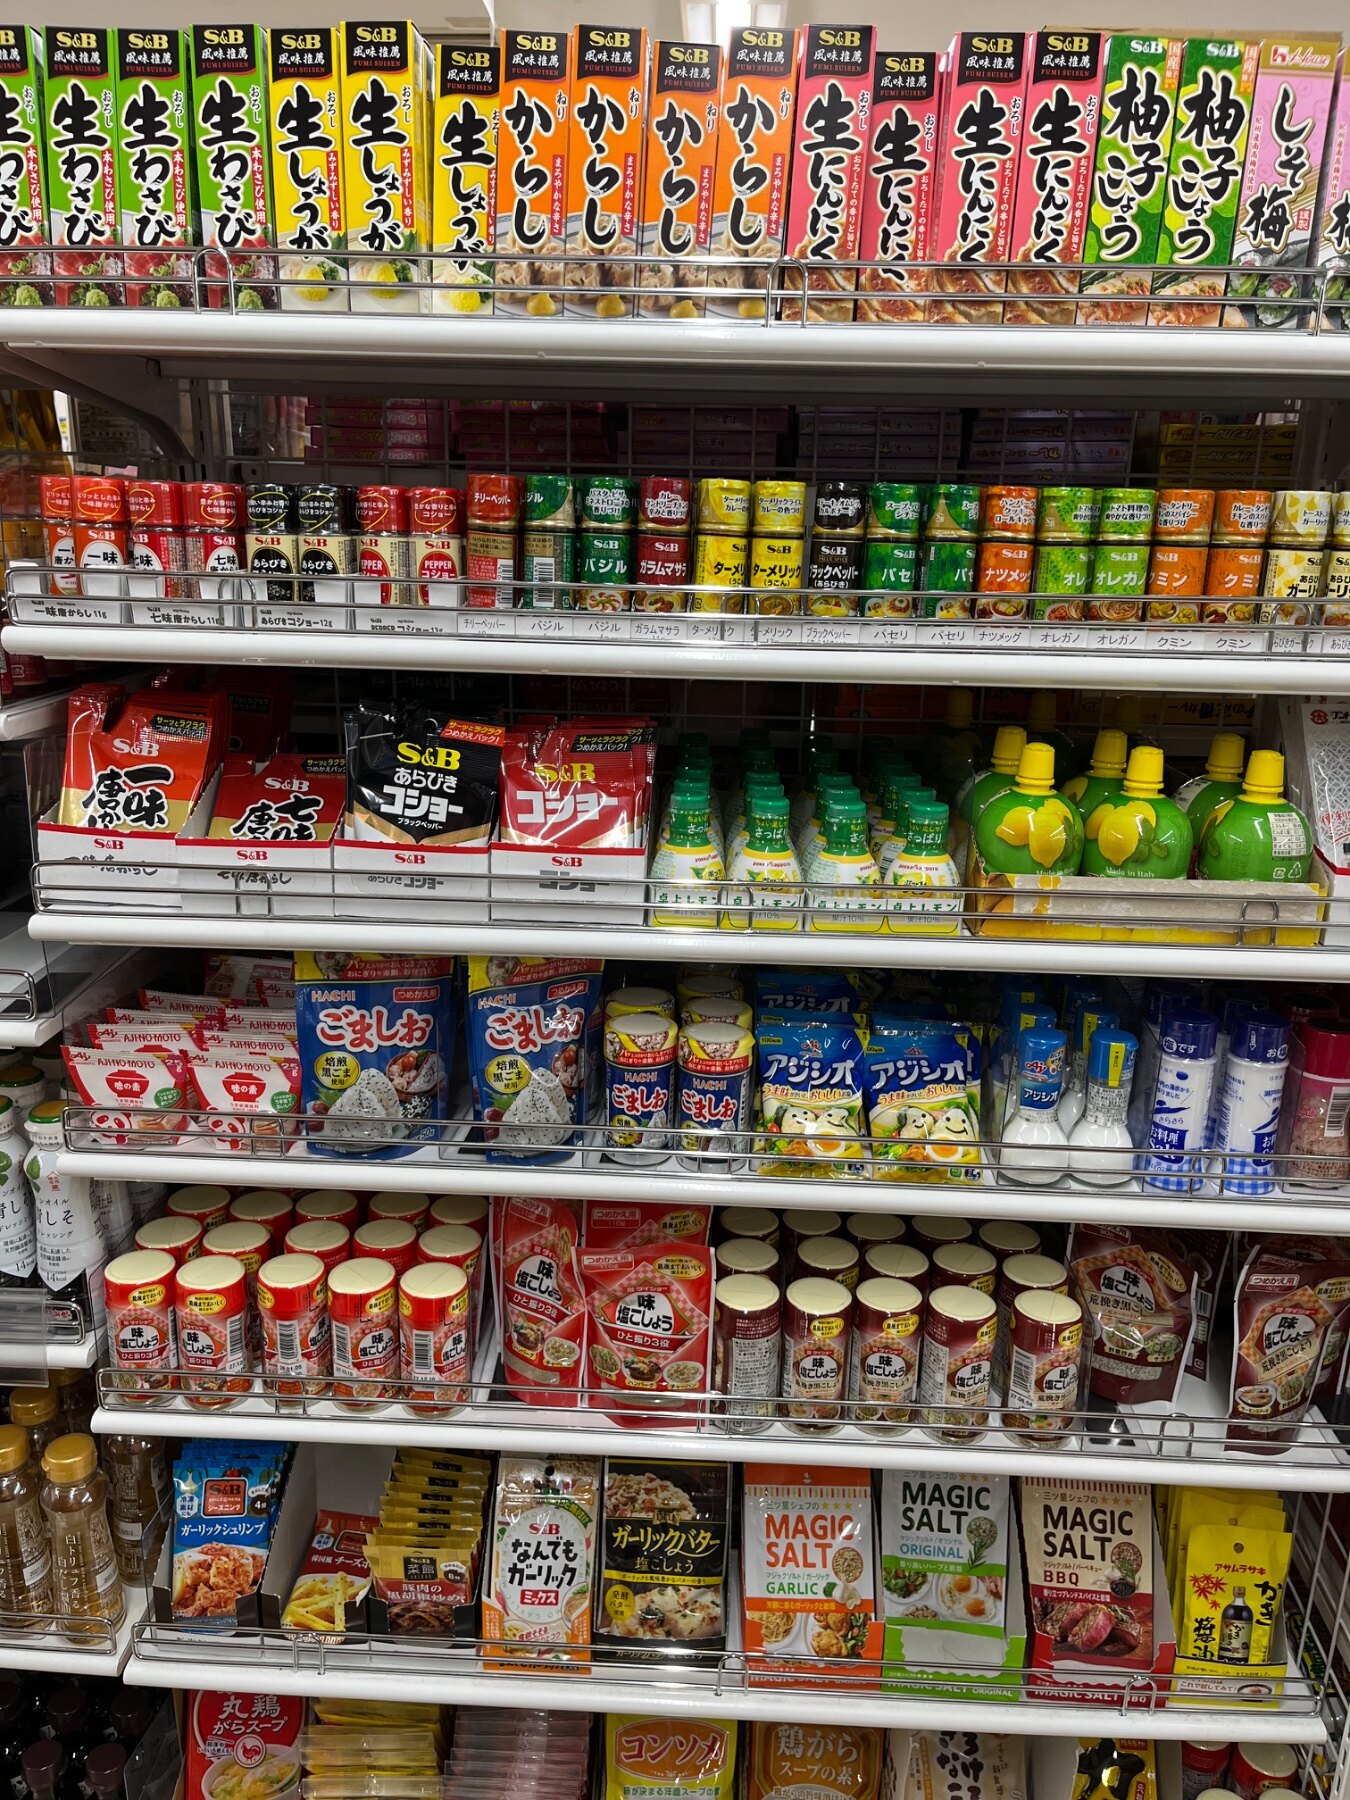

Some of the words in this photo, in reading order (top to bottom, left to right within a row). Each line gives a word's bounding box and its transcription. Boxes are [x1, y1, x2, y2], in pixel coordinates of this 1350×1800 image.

[57, 32, 96, 48] S&B
[129, 34, 168, 49] S&B
[204, 29, 244, 44] S&B
[281, 34, 321, 49] S&B
[356, 26, 397, 42] S&B
[589, 31, 630, 47] S&B
[516, 35, 556, 51] S&B
[54, 50, 100, 63] 風味推薦
[126, 51, 172, 65] 風味推薦
[202, 46, 249, 61] 風味推薦
[278, 51, 325, 65] 風味推薦
[354, 46, 400, 60] 風味推薦
[451, 51, 489, 67] S&B
[669, 47, 708, 63] S&B
[557, 91, 567, 120] ねり
[54, 83, 108, 244] 生わさび
[124, 83, 179, 246] 生わさび
[202, 79, 257, 243] 生わさび
[352, 78, 409, 250] 生しょうが
[506, 90, 552, 245] からし
[577, 87, 624, 246] からし
[728, 88, 775, 246] からし
[655, 102, 701, 254] からし
[804, 84, 859, 260] 生にんにく
[956, 90, 1012, 261] 生にんにく
[1030, 88, 1087, 262] 生にんにく
[553, 156, 562, 233] まろやかな辛さ
[475, 493, 511, 503] チリーペッパー
[88, 530, 115, 540] S&B
[214, 536, 235, 545] S&B
[255, 537, 281, 545] S&B
[304, 539, 327, 547] S&B
[425, 541, 450, 549] S&B
[594, 540, 618, 549] S&B
[87, 552, 118, 564] 一味
[253, 560, 287, 568] あらびき
[425, 560, 452, 570] PEPPER
[585, 558, 627, 573] バジル
[640, 560, 687, 575] ガラムマサラ
[464, 619, 506, 628] チリーペッパー
[532, 621, 564, 631] バジル
[588, 622, 621, 632] バジル
[635, 624, 679, 634] ガラムマサラ
[807, 628, 852, 638] ブラックペッパー
[874, 629, 908, 639] パセリ
[931, 632, 965, 641] パセリ
[979, 633, 1022, 643] ナツメッグ
[1041, 633, 1080, 643] オレガノ
[1097, 634, 1137, 645] オレガノ
[1157, 637, 1192, 648] クミン
[1216, 638, 1251, 648] クミン
[113, 738, 159, 756] S&B
[397, 742, 461, 770] S&B
[533, 762, 596, 783] S&B
[264, 778, 309, 791] S&B
[394, 768, 458, 793] あらびき
[380, 785, 463, 822] コショー
[516, 790, 618, 824] コショー
[398, 817, 443, 830] ブラックペッパー
[94, 839, 124, 850] S&B
[237, 851, 268, 860] S&B
[394, 854, 425, 864] S&B
[552, 857, 582, 867] S&B
[311, 990, 355, 1002] HACHI
[397, 988, 437, 1000] つめかえ用
[319, 1008, 433, 1049] ごましお
[487, 1007, 583, 1051] ごましお
[322, 1068, 351, 1079] 黒ごま
[625, 1072, 657, 1083] HACHI
[764, 1055, 854, 1085] アジシオ
[871, 1061, 965, 1090] アジシオ
[114, 1082, 141, 1092] 味の素
[231, 1084, 257, 1094] 味の素
[693, 1079, 727, 1090] HACHI
[612, 1084, 668, 1114] ごましお
[1024, 1088, 1059, 1102] アジシオ
[682, 1090, 737, 1121] ごましお
[537, 1260, 554, 1280] 味
[516, 1269, 562, 1301] 塩こしょう
[1122, 1270, 1141, 1289] 味
[1102, 1275, 1154, 1311] 塩こしょう
[513, 1293, 557, 1319] ひと振り3役
[638, 1294, 655, 1310] 味
[618, 1306, 673, 1332] 塩こしょう
[1278, 1316, 1297, 1329] 味
[131, 1327, 144, 1338] 味
[187, 1331, 199, 1342] 味
[372, 1332, 384, 1345] 味
[617, 1330, 670, 1348] ひと振り3役
[812, 1357, 824, 1368] 味
[209, 1485, 241, 1495] S&B
[902, 1481, 990, 1511] MAGIC
[1043, 1491, 1098, 1504] 三ツ星シェフの
[766, 1502, 819, 1510] 三ツ星シェフの
[766, 1514, 854, 1540] MAGIC
[901, 1506, 968, 1534] SALT
[1043, 1505, 1133, 1536] MAGIC
[181, 1522, 265, 1536] ガーリックシュリンプ
[613, 1525, 720, 1552] ガーリックバター
[512, 1537, 578, 1563] なんでも
[900, 1543, 963, 1558] ORIGINAL
[1043, 1532, 1112, 1561] SALT
[766, 1542, 833, 1568] SALT
[635, 1557, 694, 1573] 塩こしょう
[1214, 1563, 1266, 1575] アサムラサキ
[509, 1564, 578, 1588] ガーリック
[1044, 1571, 1079, 1586] BBQ
[402, 1584, 442, 1593] 豚肉の
[766, 1582, 818, 1595] GARLIC
[523, 1590, 556, 1604] ミックス
[222, 1695, 279, 1718] 丸鶏
[213, 1718, 288, 1734] がらスープ
[622, 1734, 722, 1764] コンソメ
[777, 1724, 858, 1763] 鶏がら
[781, 1761, 852, 1785] スープの素
